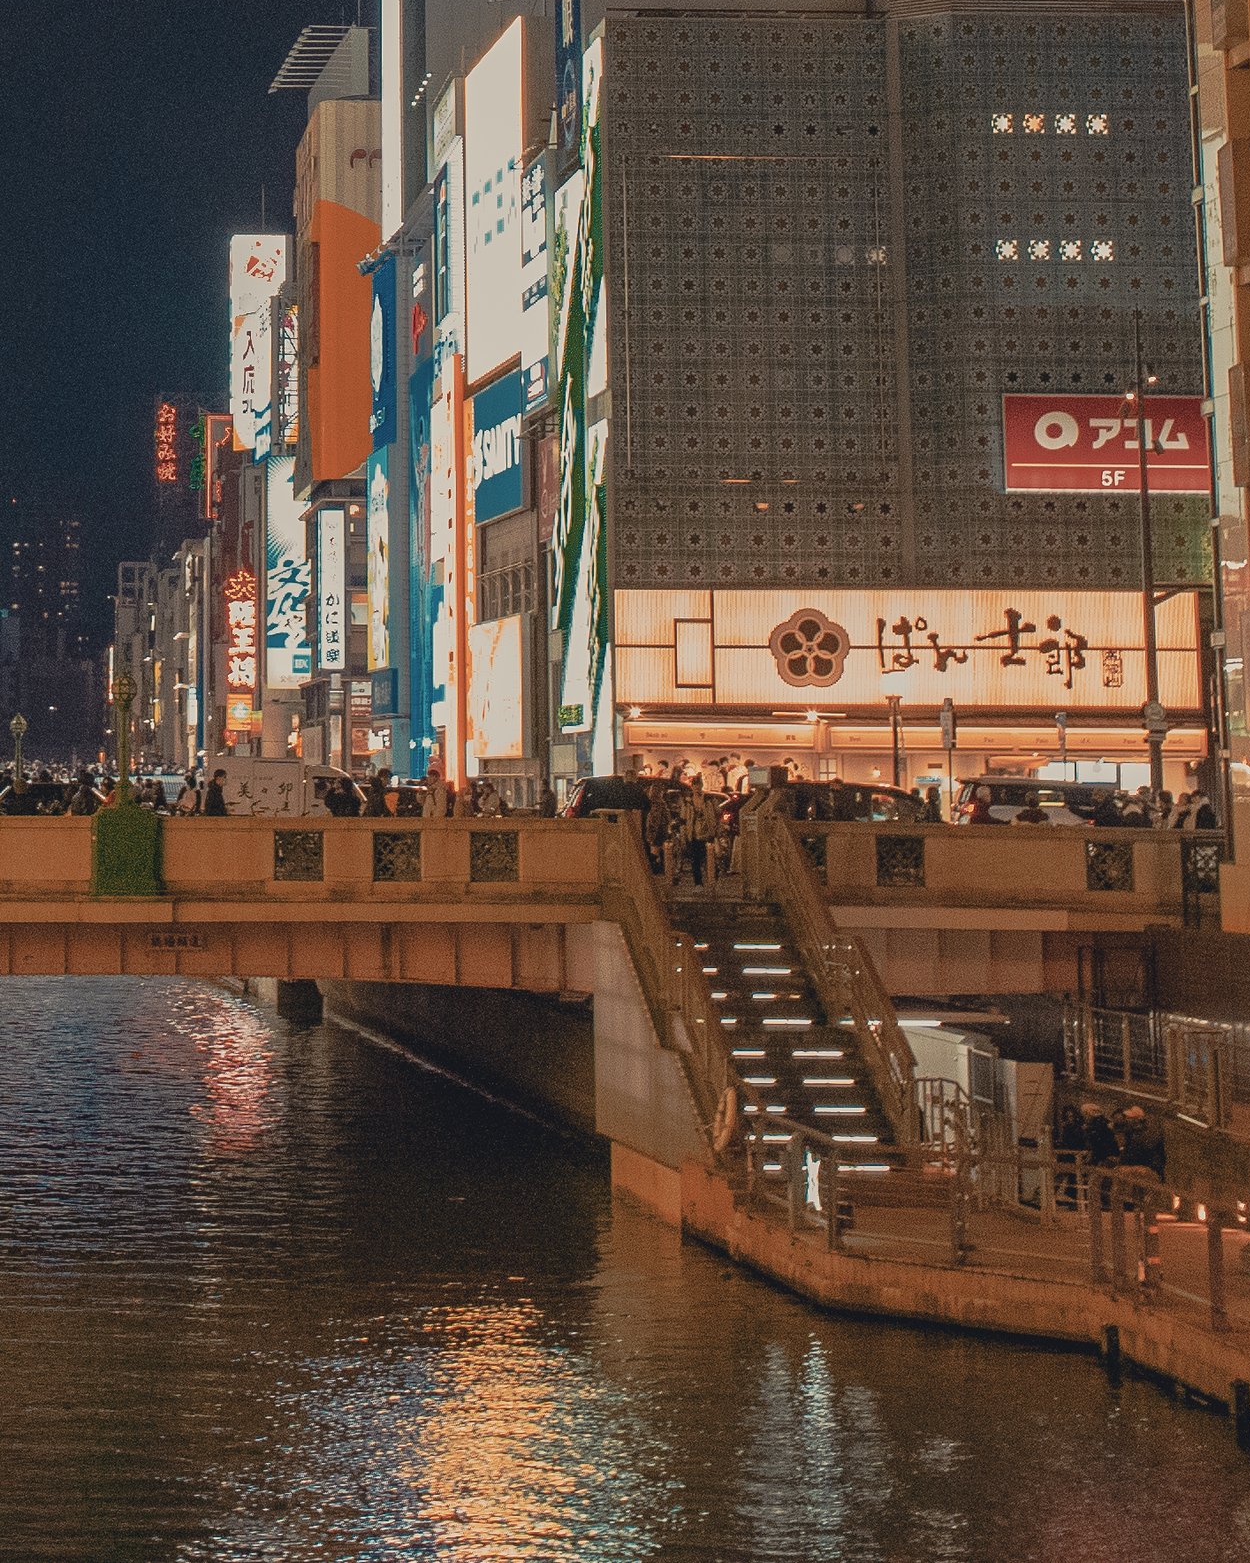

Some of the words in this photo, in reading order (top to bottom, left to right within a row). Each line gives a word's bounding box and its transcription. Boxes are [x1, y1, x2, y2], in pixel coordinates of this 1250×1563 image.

[1089, 418, 1190, 450] アコム
[1101, 470, 1126, 487] 5F
[325, 593, 341, 663] かに道楽
[875, 607, 1088, 690] ぱん士郎
